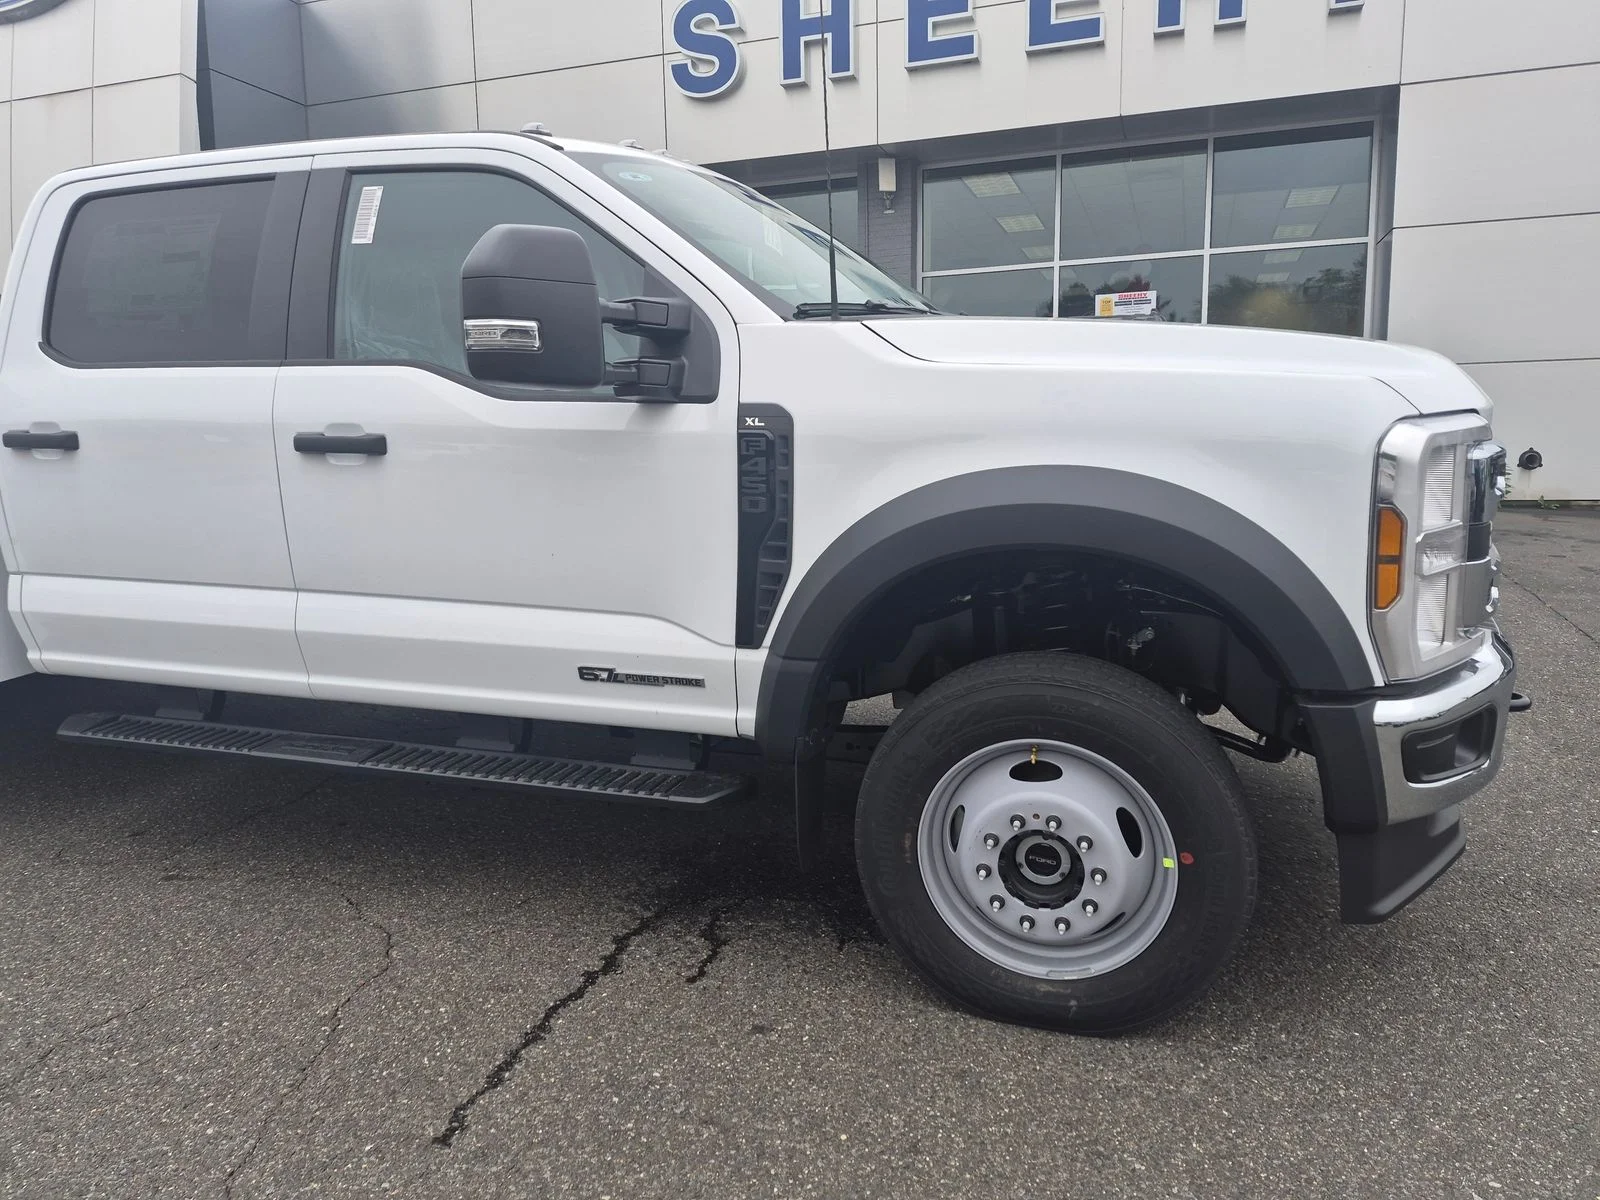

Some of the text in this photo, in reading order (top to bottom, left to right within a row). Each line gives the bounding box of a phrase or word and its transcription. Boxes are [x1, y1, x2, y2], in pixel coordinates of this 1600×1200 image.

[668, 0, 1364, 98] SHE
[744, 417, 765, 426] XL
[625, 673, 661, 685] POWER
[661, 676, 703, 687] STROKE
